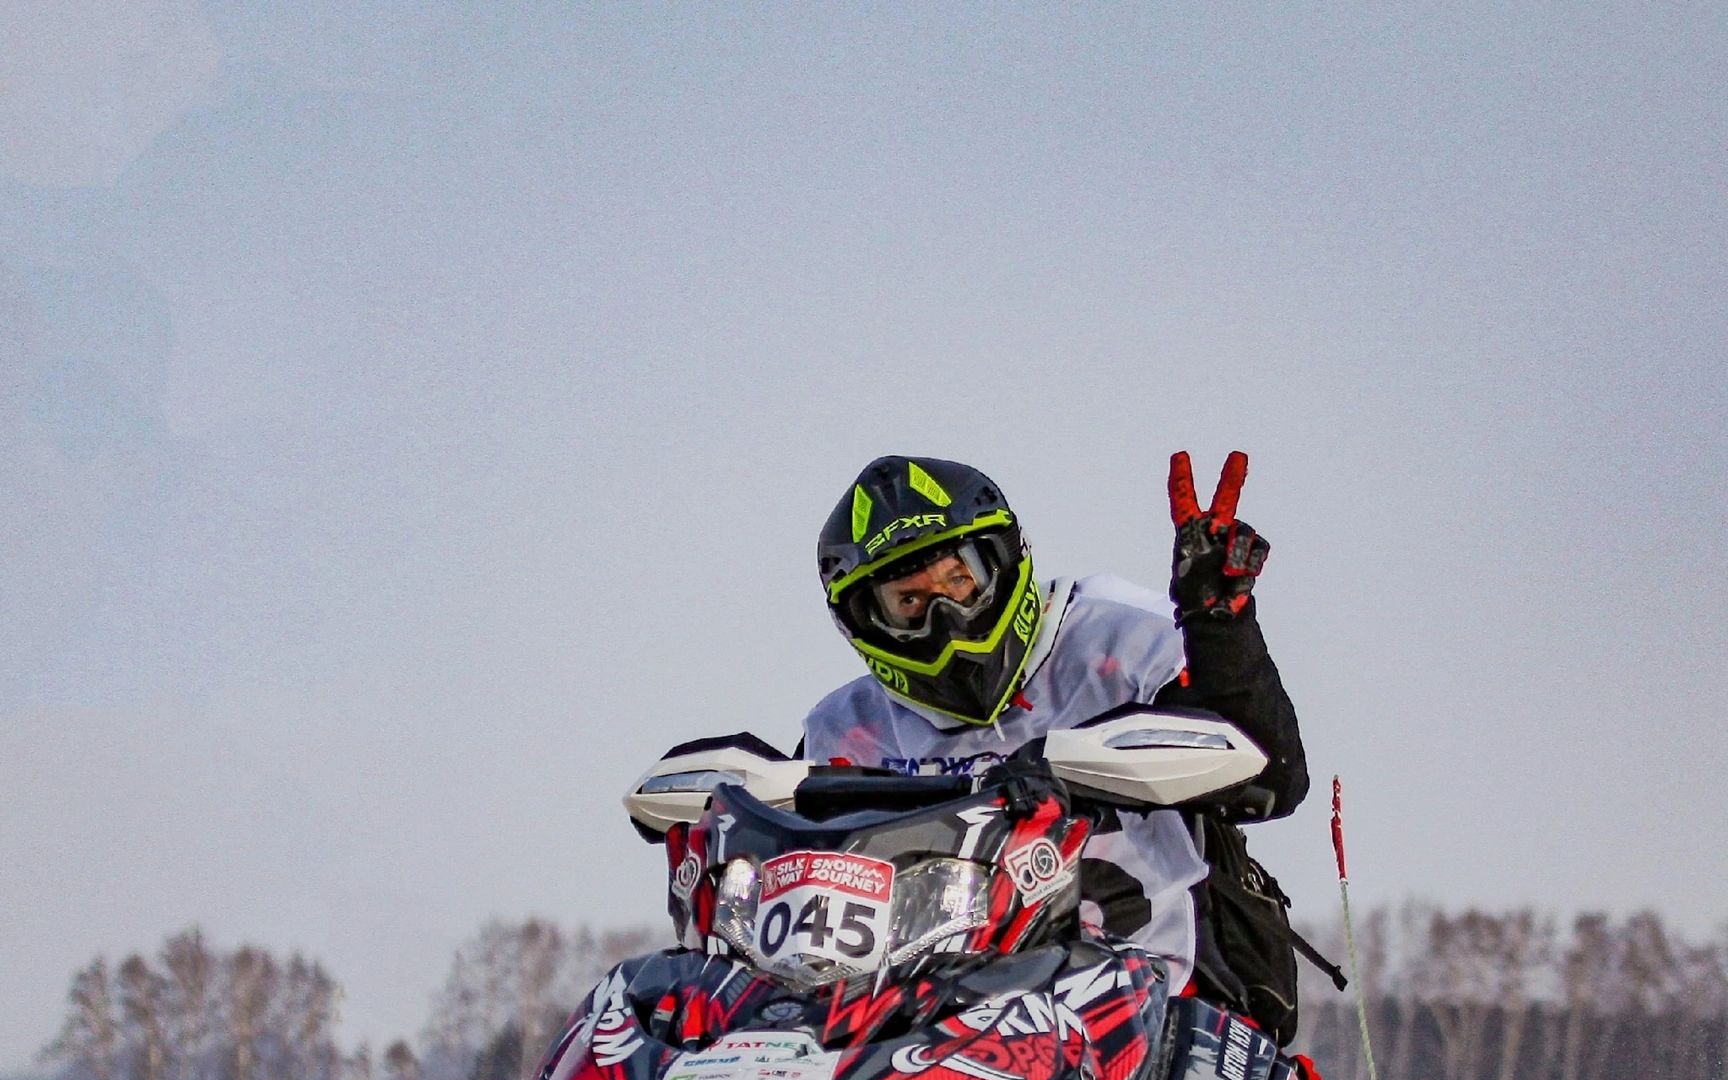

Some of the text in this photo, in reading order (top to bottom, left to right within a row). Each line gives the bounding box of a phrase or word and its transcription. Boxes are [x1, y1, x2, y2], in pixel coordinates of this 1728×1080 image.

[776, 857, 807, 876] SILK
[811, 858, 864, 876] SNOW
[777, 868, 804, 888] WAY
[807, 868, 886, 894] JOURNEY
[759, 894, 876, 958] 045
[725, 1041, 808, 1055] TATNE
